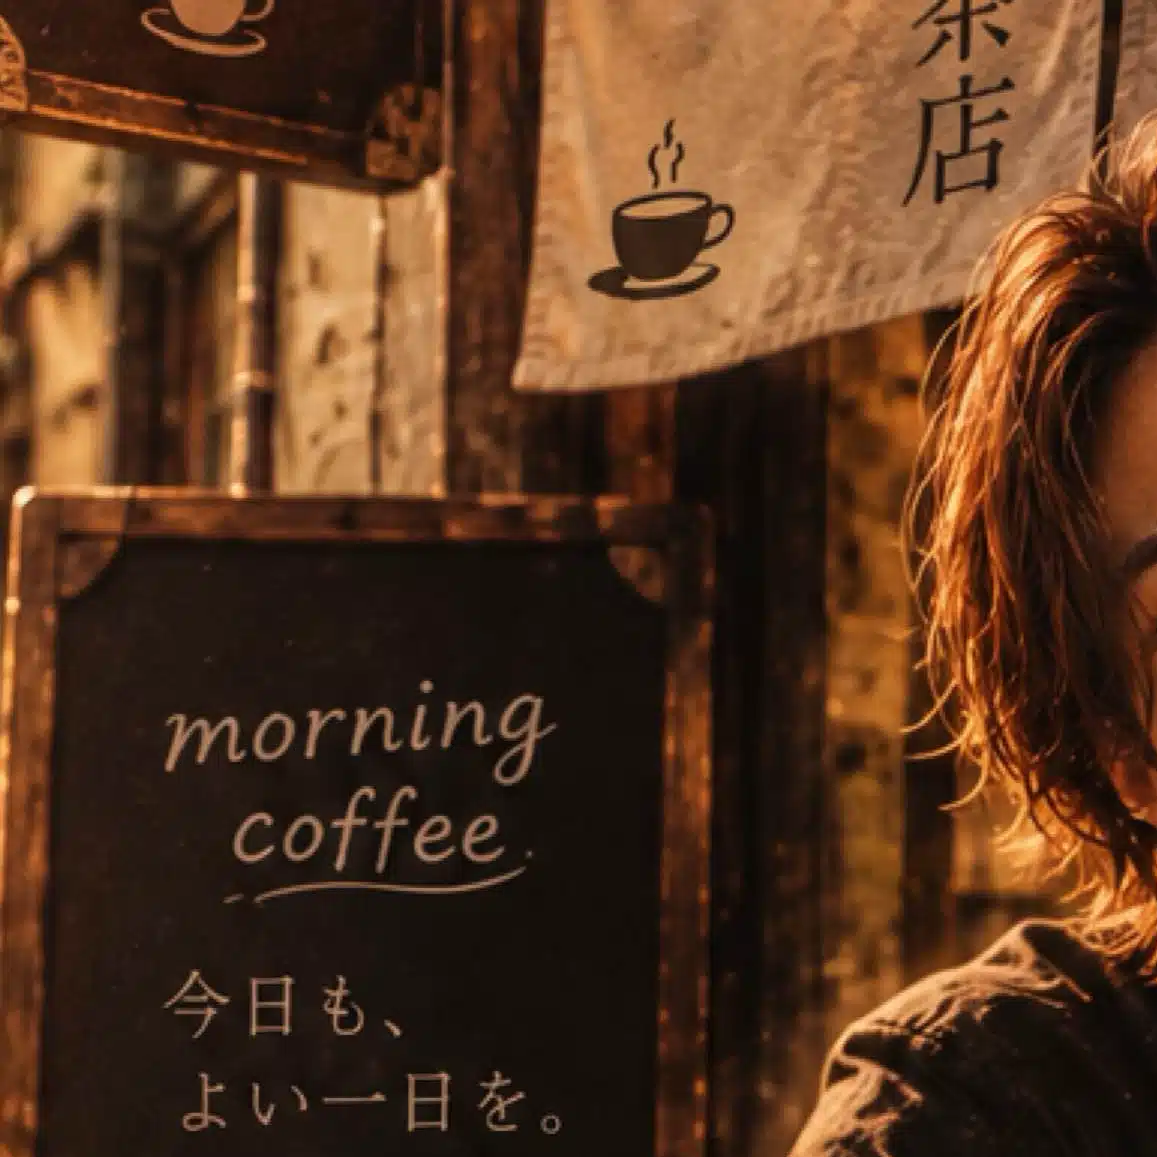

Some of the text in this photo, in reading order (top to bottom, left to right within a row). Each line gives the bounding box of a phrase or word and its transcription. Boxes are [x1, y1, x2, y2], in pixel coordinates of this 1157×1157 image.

[163, 679, 558, 786] morning
[163, 968, 404, 1039] 今日も、
[181, 1069, 564, 1136] よい一日を。
